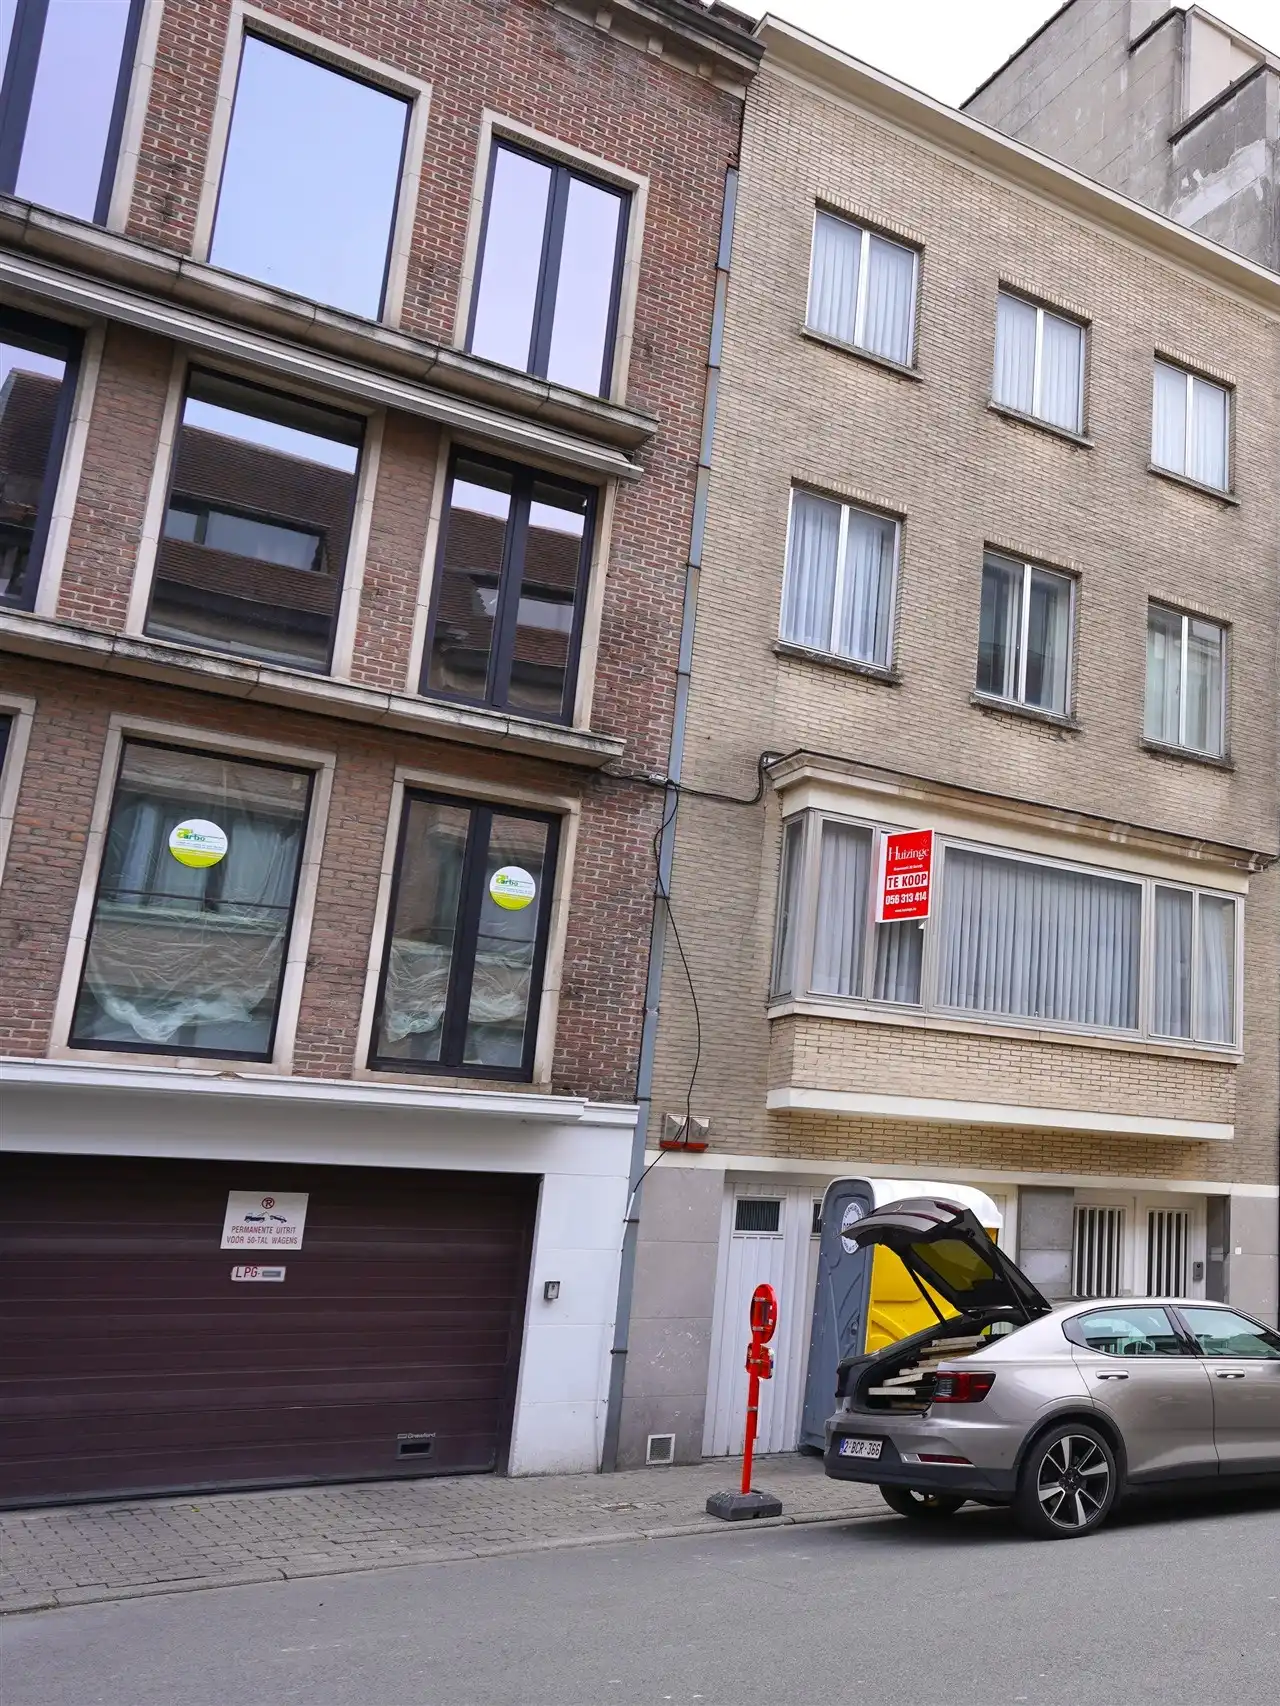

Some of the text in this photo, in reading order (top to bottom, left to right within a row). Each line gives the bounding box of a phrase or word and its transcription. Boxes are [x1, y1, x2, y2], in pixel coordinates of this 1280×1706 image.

[888, 873, 927, 889] TE KOOP
[901, 892, 914, 903] 313
[915, 891, 927, 902] 414
[231, 1225, 297, 1234] PERMANENTE UITRIT
[226, 1235, 245, 1244] VOOR
[271, 1236, 298, 1245] WAGENS
